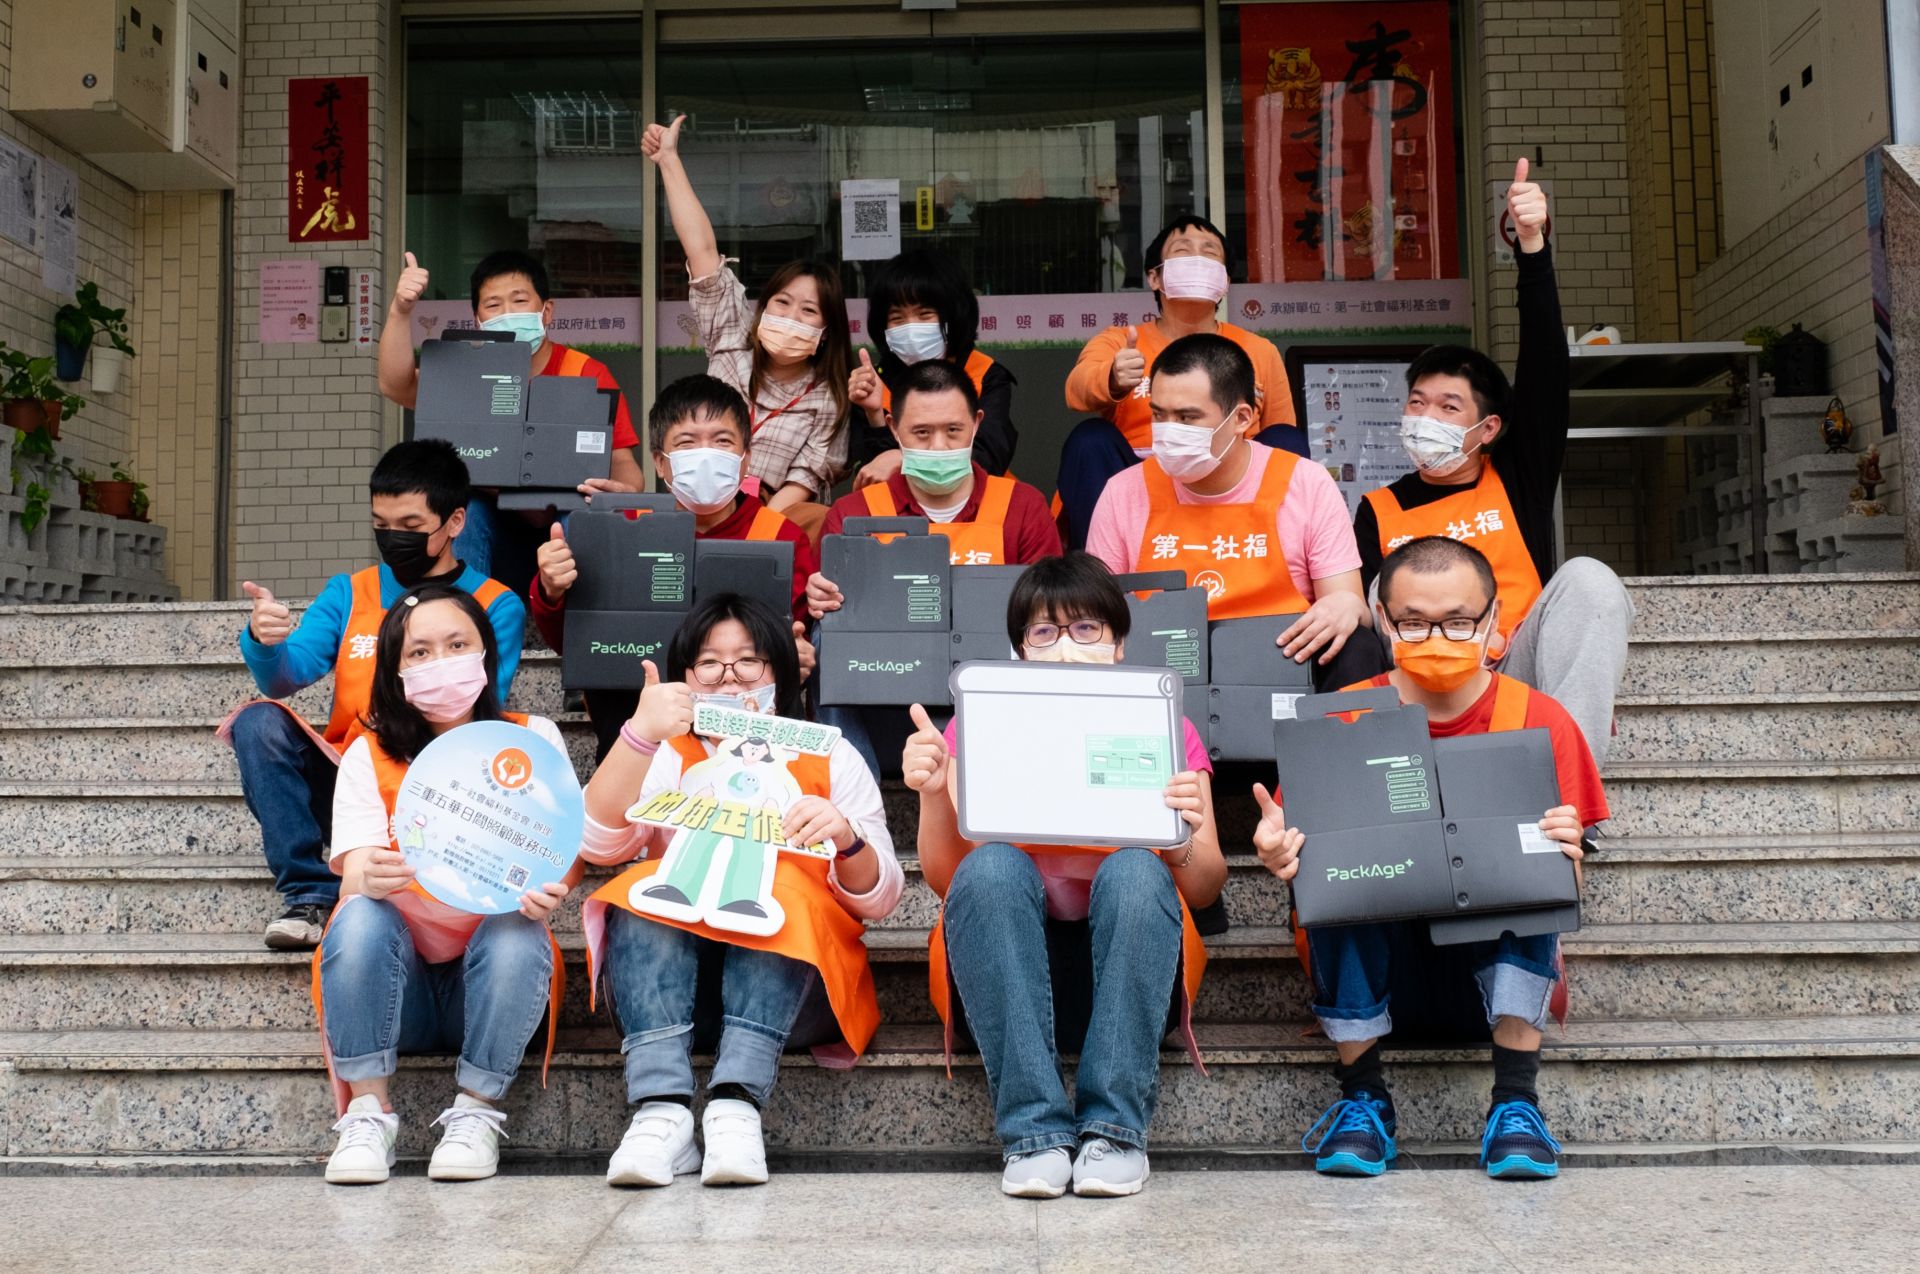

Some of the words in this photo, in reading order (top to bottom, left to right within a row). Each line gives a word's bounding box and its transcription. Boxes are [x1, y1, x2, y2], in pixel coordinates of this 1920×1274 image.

[360, 274, 369, 326] 訪客請按鈴
[1386, 509, 1504, 549] 社福
[1151, 533, 1268, 560] 第一社福
[348, 633, 379, 660] 第
[590, 641, 663, 657] PackAge+
[848, 659, 922, 675] PackAge+
[697, 707, 838, 752] 我接受挑戰！
[407, 781, 565, 867] 三重五華日間照顧服務中心
[631, 790, 829, 857] 地球正循
[1326, 858, 1415, 882] PackAge+
